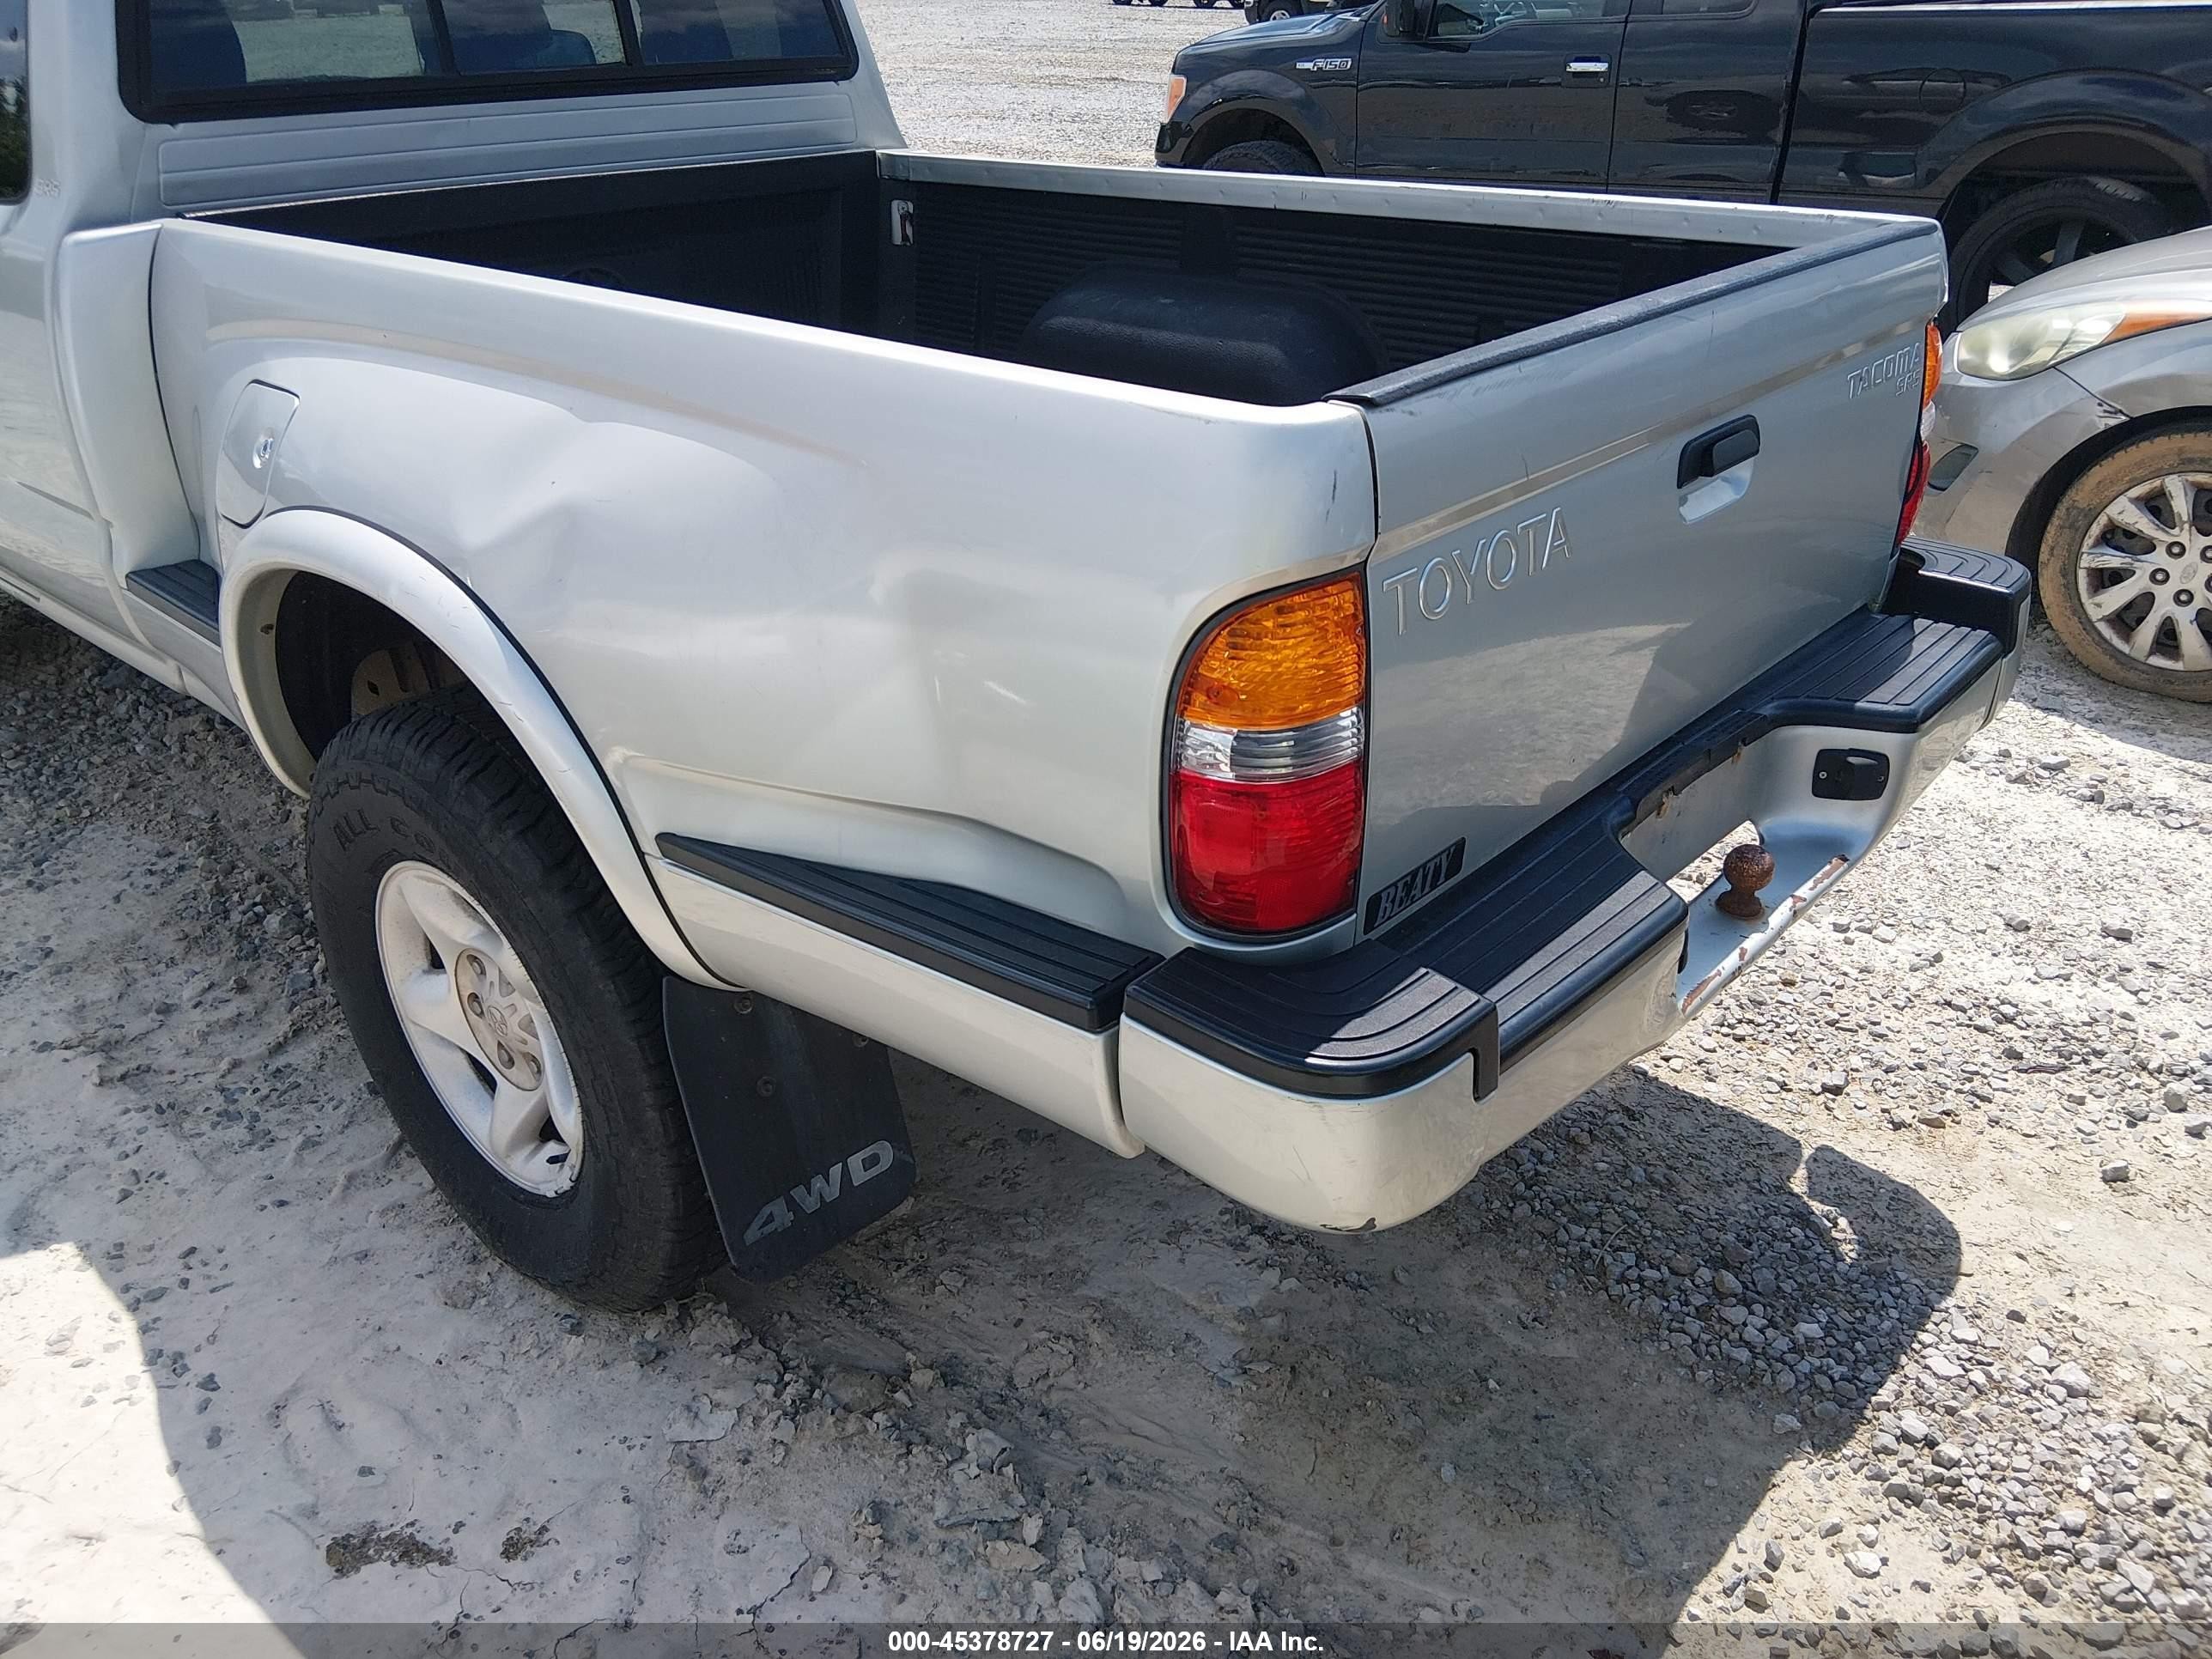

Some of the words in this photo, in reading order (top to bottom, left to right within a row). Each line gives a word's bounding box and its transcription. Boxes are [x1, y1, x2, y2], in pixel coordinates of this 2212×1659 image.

[1847, 342, 1922, 399] TACOMA
[1382, 507, 1572, 636] TOYOTA
[331, 808, 375, 851] ALL
[1373, 844, 1457, 928] BEATY
[743, 1139, 894, 1247] 4WD
